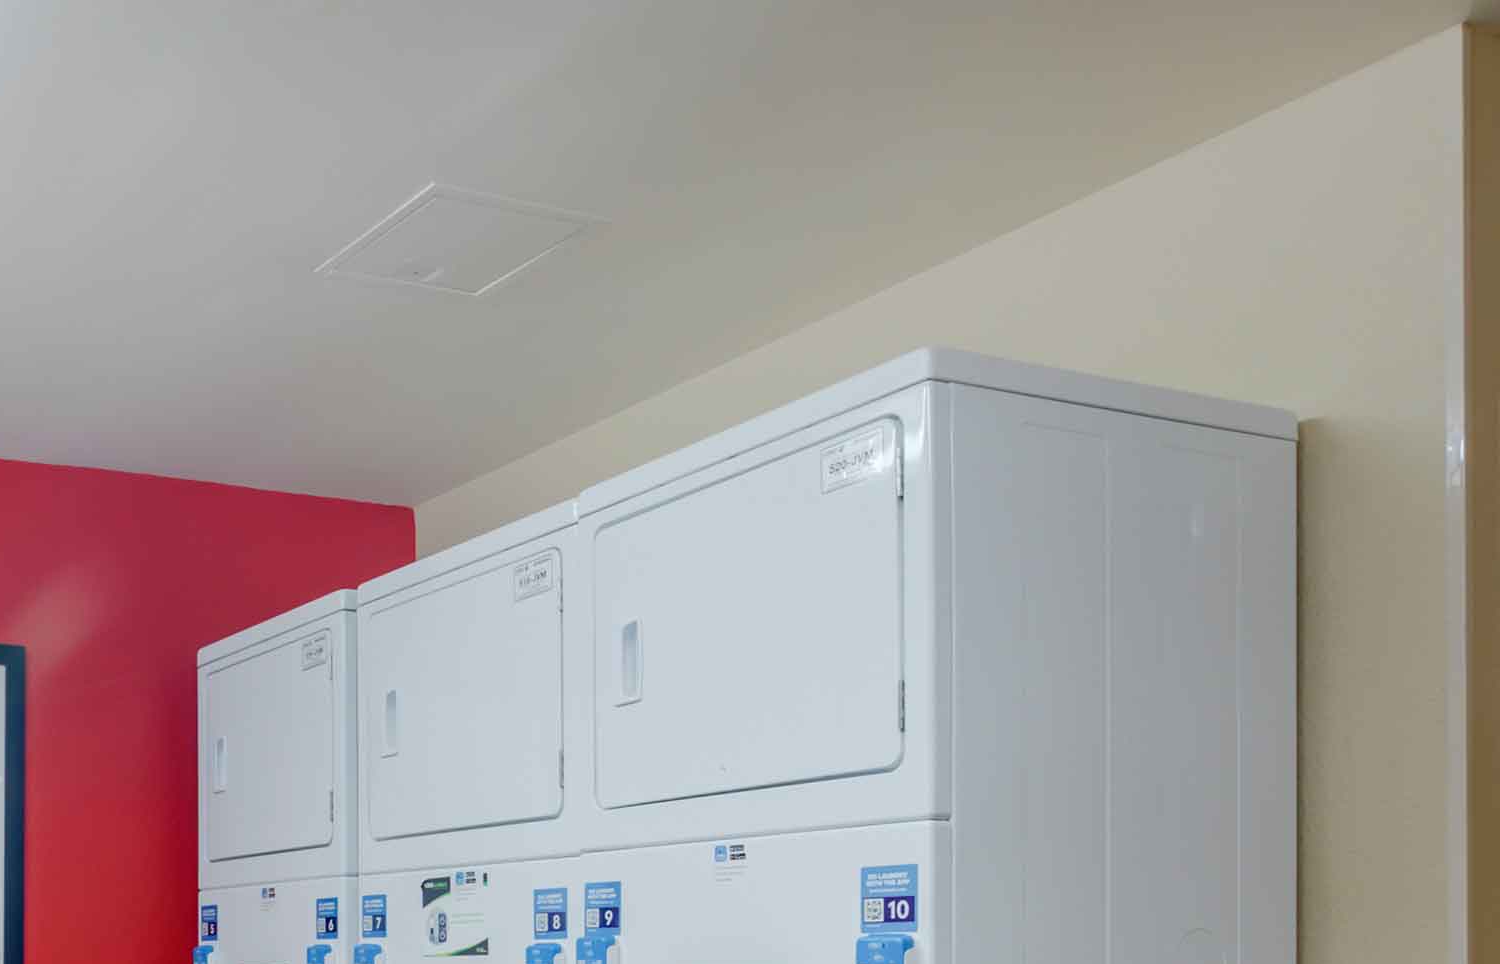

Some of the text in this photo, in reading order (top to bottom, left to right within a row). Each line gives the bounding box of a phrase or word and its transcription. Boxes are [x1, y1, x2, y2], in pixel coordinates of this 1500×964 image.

[887, 900, 910, 920] 10
[328, 919, 335, 931] 6
[375, 917, 382, 929] 7
[552, 914, 561, 930] 8
[604, 910, 614, 926] 9
[210, 923, 215, 934] 5
